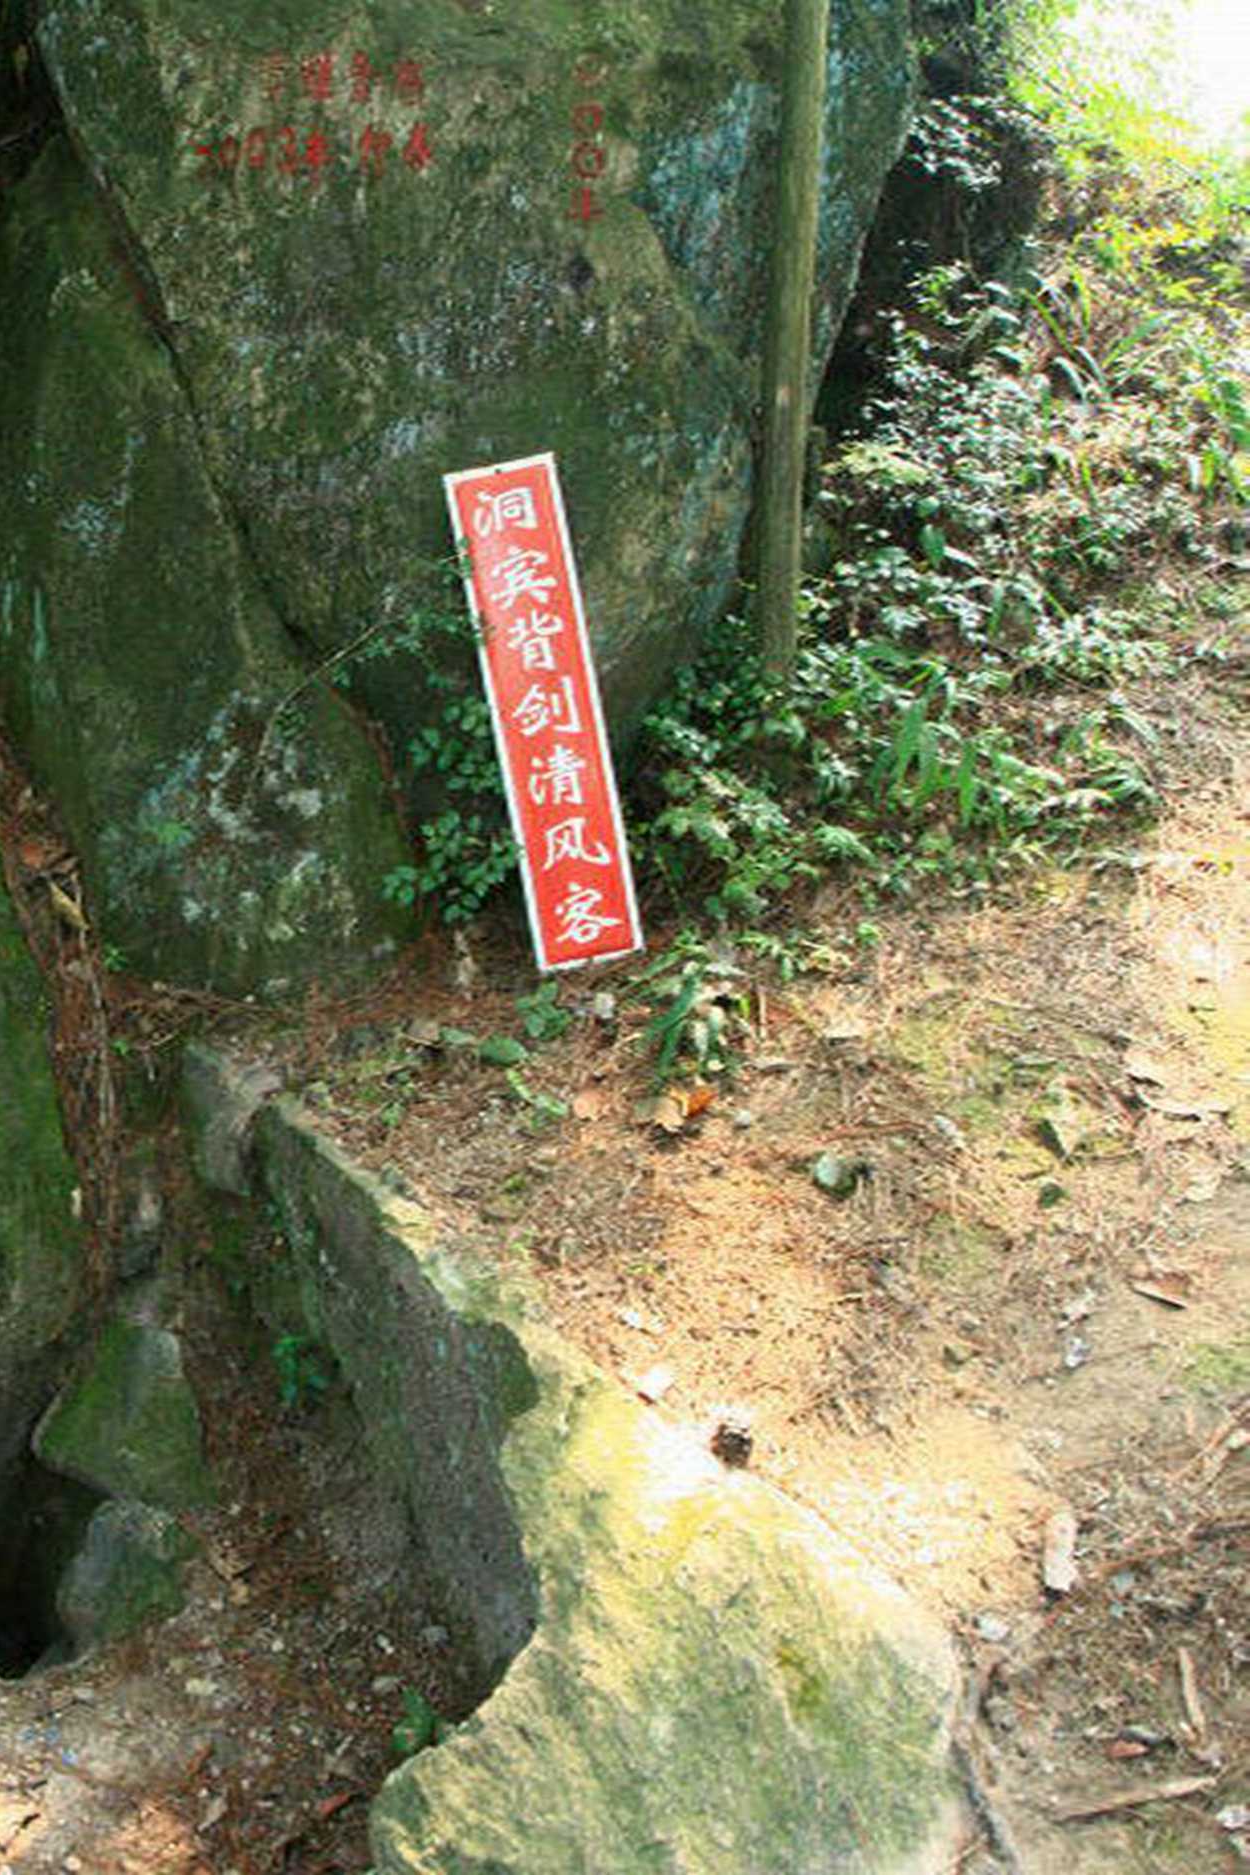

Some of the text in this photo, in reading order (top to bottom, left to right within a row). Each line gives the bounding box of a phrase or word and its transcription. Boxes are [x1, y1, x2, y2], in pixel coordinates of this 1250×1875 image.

[472, 485, 622, 944] 洞宾背剑清风客
